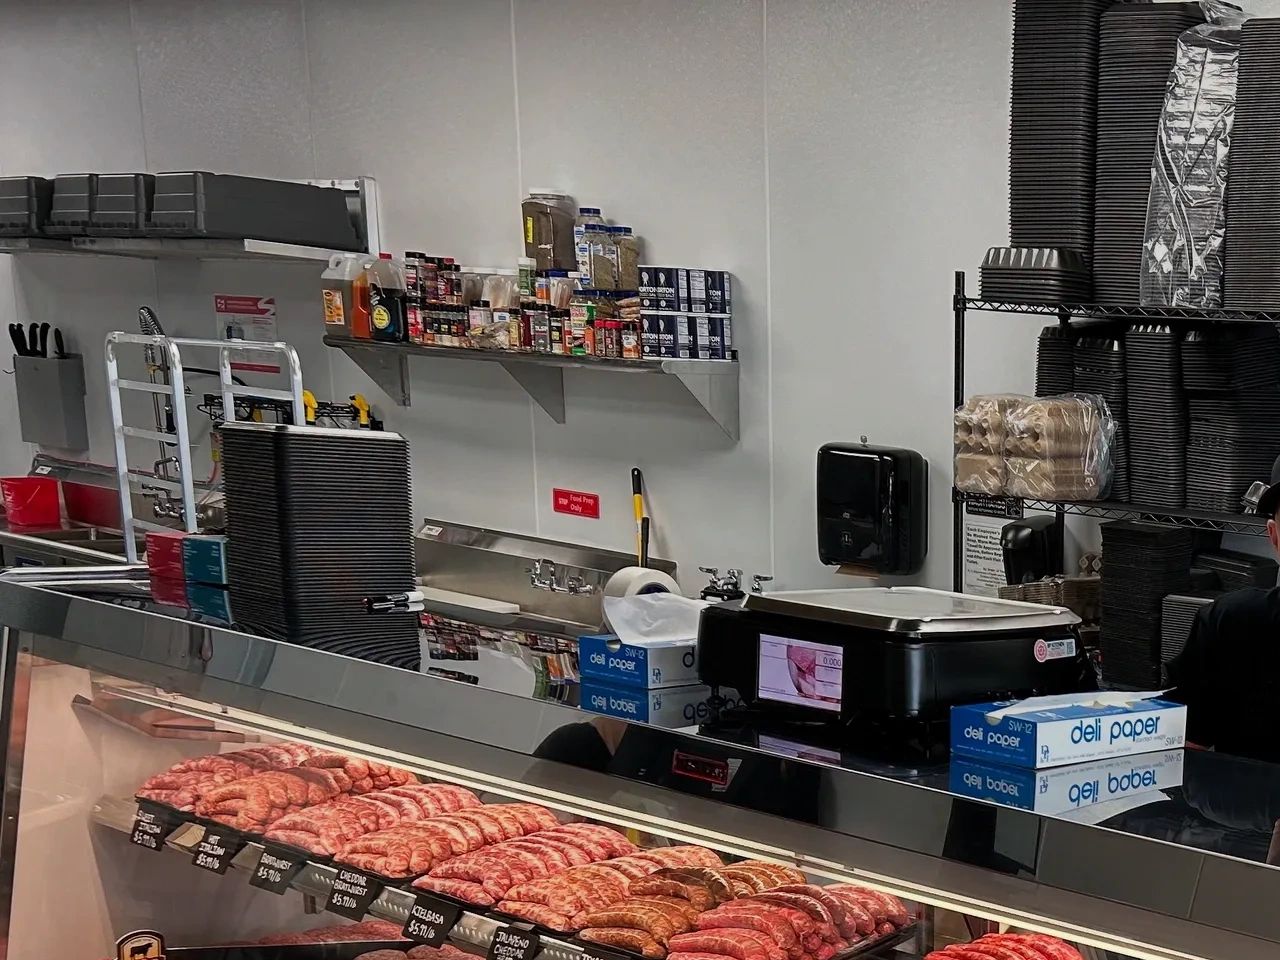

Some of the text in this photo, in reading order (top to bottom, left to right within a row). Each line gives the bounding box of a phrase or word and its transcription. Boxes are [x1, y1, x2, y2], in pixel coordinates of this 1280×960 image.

[571, 504, 582, 513] Only
[583, 496, 594, 506] Prep
[590, 653, 636, 671] deli paper
[1008, 720, 1033, 734] SW-12
[1071, 716, 1161, 745] deli paper
[964, 726, 1021, 748] deli paper
[411, 904, 444, 925] KIELBASA
